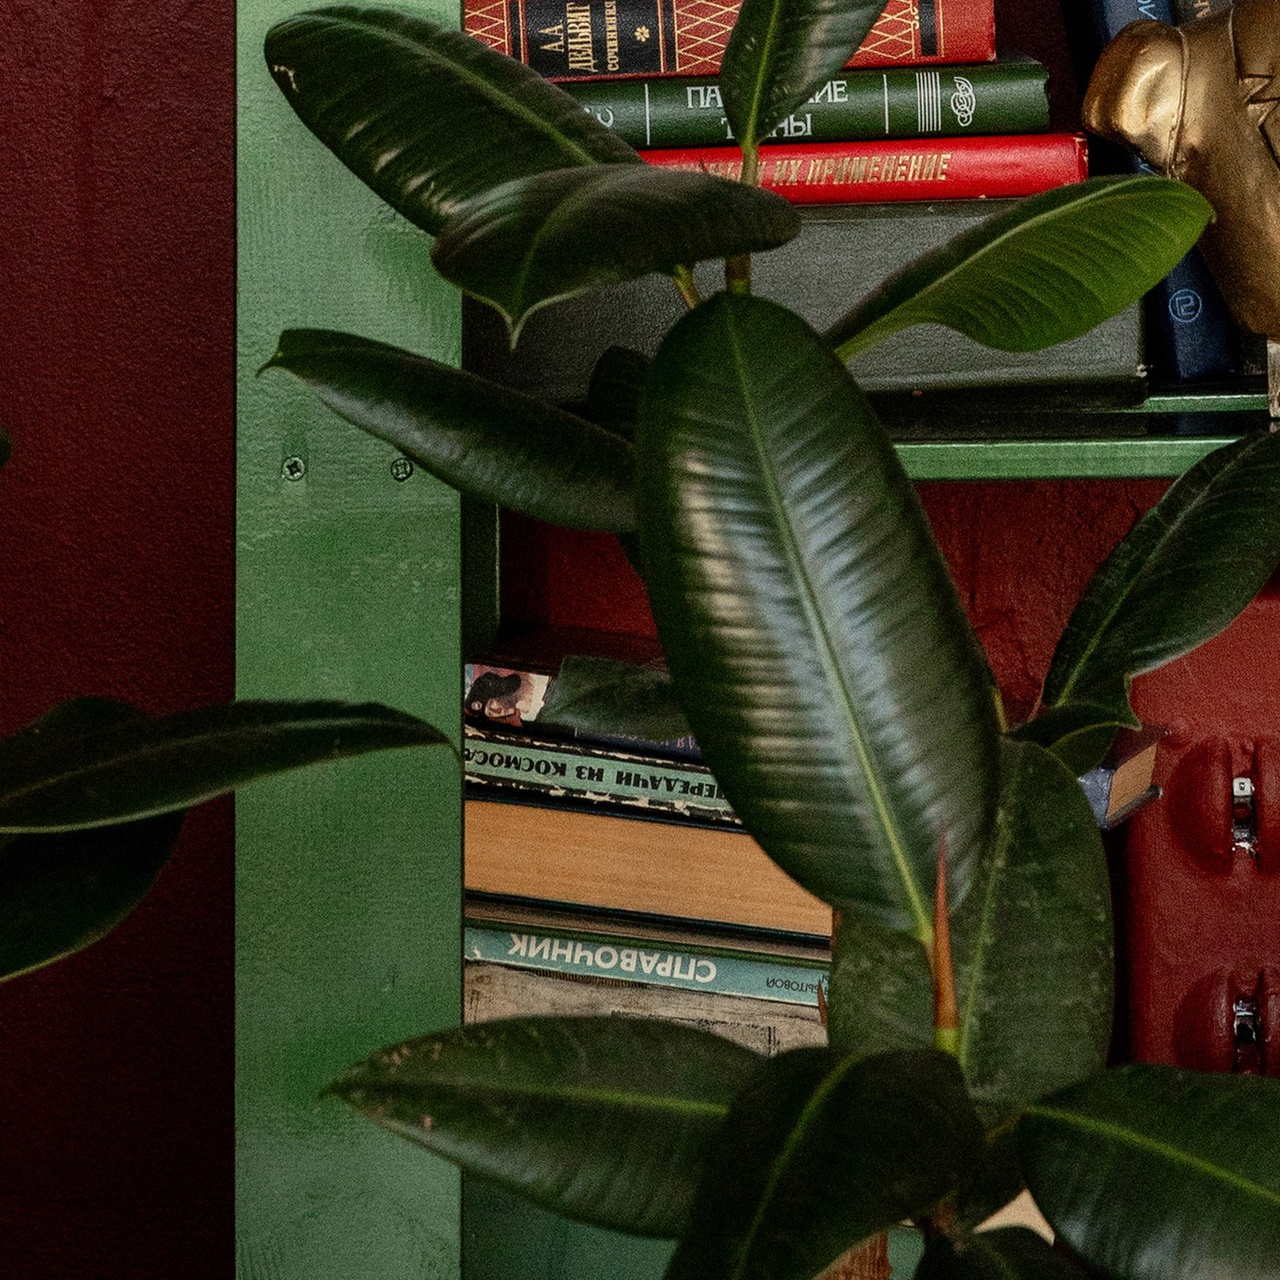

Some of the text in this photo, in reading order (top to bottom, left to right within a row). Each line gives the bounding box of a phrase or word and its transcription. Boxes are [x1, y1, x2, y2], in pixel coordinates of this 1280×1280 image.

[567, 1, 599, 73] ДЕЛЬВИГ
[604, 0, 619, 72] СОЧИНЕНИЯ
[806, 152, 953, 185] ПРИМЕНЕНИЕ
[574, 765, 605, 783] ИЗ
[507, 931, 718, 984] СПРАВОЧНИК
